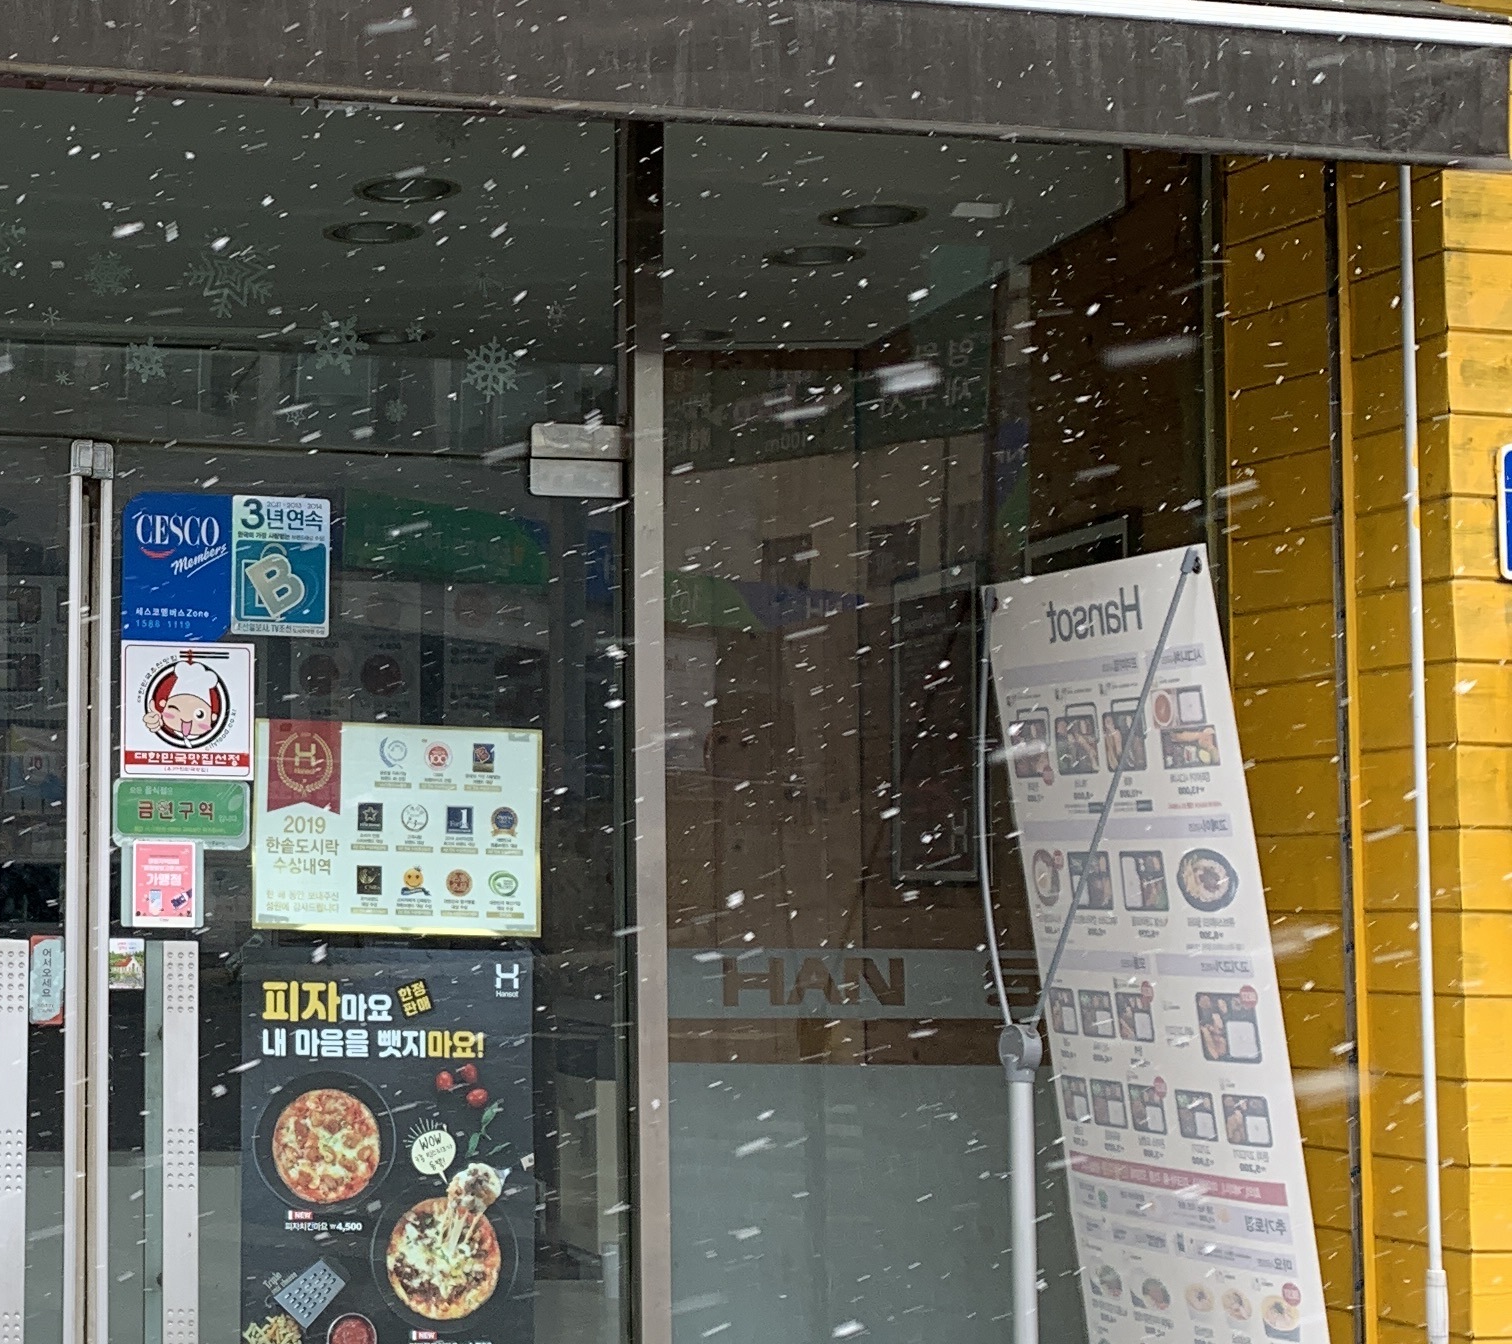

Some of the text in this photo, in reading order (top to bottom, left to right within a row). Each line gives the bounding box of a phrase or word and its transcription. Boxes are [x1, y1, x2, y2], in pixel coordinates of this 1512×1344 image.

[136, 513, 220, 546] CESCO
[171, 543, 228, 576] Members
[134, 751, 241, 767] 대한민국맛집선정
[138, 799, 214, 822] 금연구역
[283, 815, 327, 835] 2019
[265, 836, 340, 856] 한솥도시락
[273, 857, 332, 876] 수상내역
[262, 981, 393, 1022] 피자마요
[397, 981, 428, 1003] 한정
[403, 995, 433, 1017] 판매
[262, 1028, 484, 1058] 내 마음을 뺏지마요!
